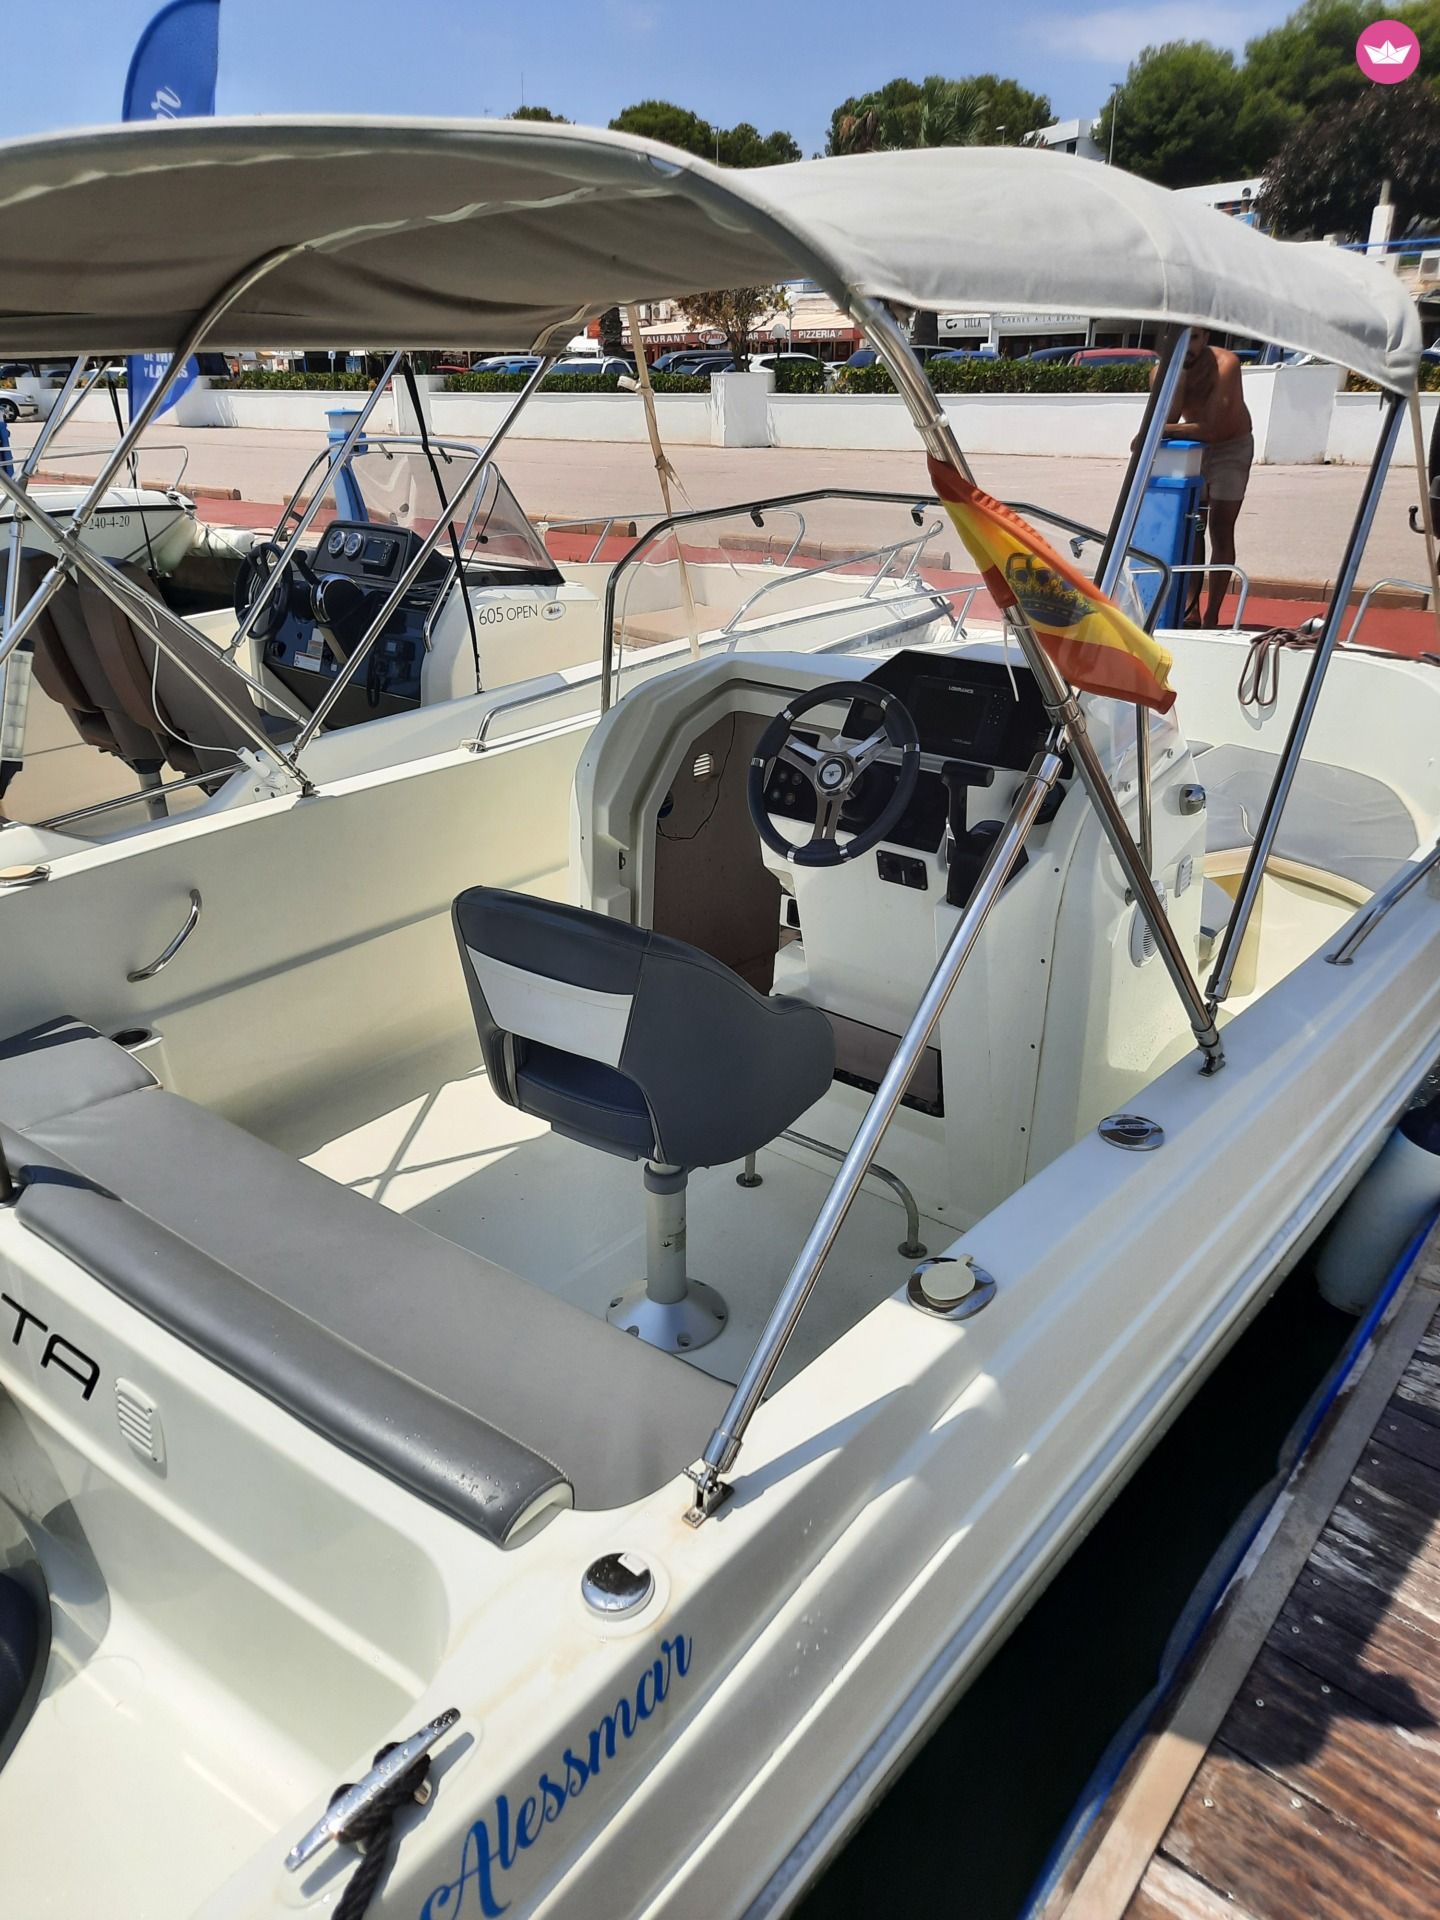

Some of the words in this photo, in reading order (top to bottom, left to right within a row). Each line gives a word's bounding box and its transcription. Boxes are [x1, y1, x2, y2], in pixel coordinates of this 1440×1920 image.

[622, 334, 687, 344] RETAURANT
[746, 332, 759, 340] AR
[766, 331, 791, 340] TAS
[799, 329, 836, 339] PIZZERIA
[479, 606, 504, 625] 605
[506, 603, 538, 621] OPEN
[1, 1292, 100, 1401] TA
[420, 1633, 692, 1920] Alessmar
